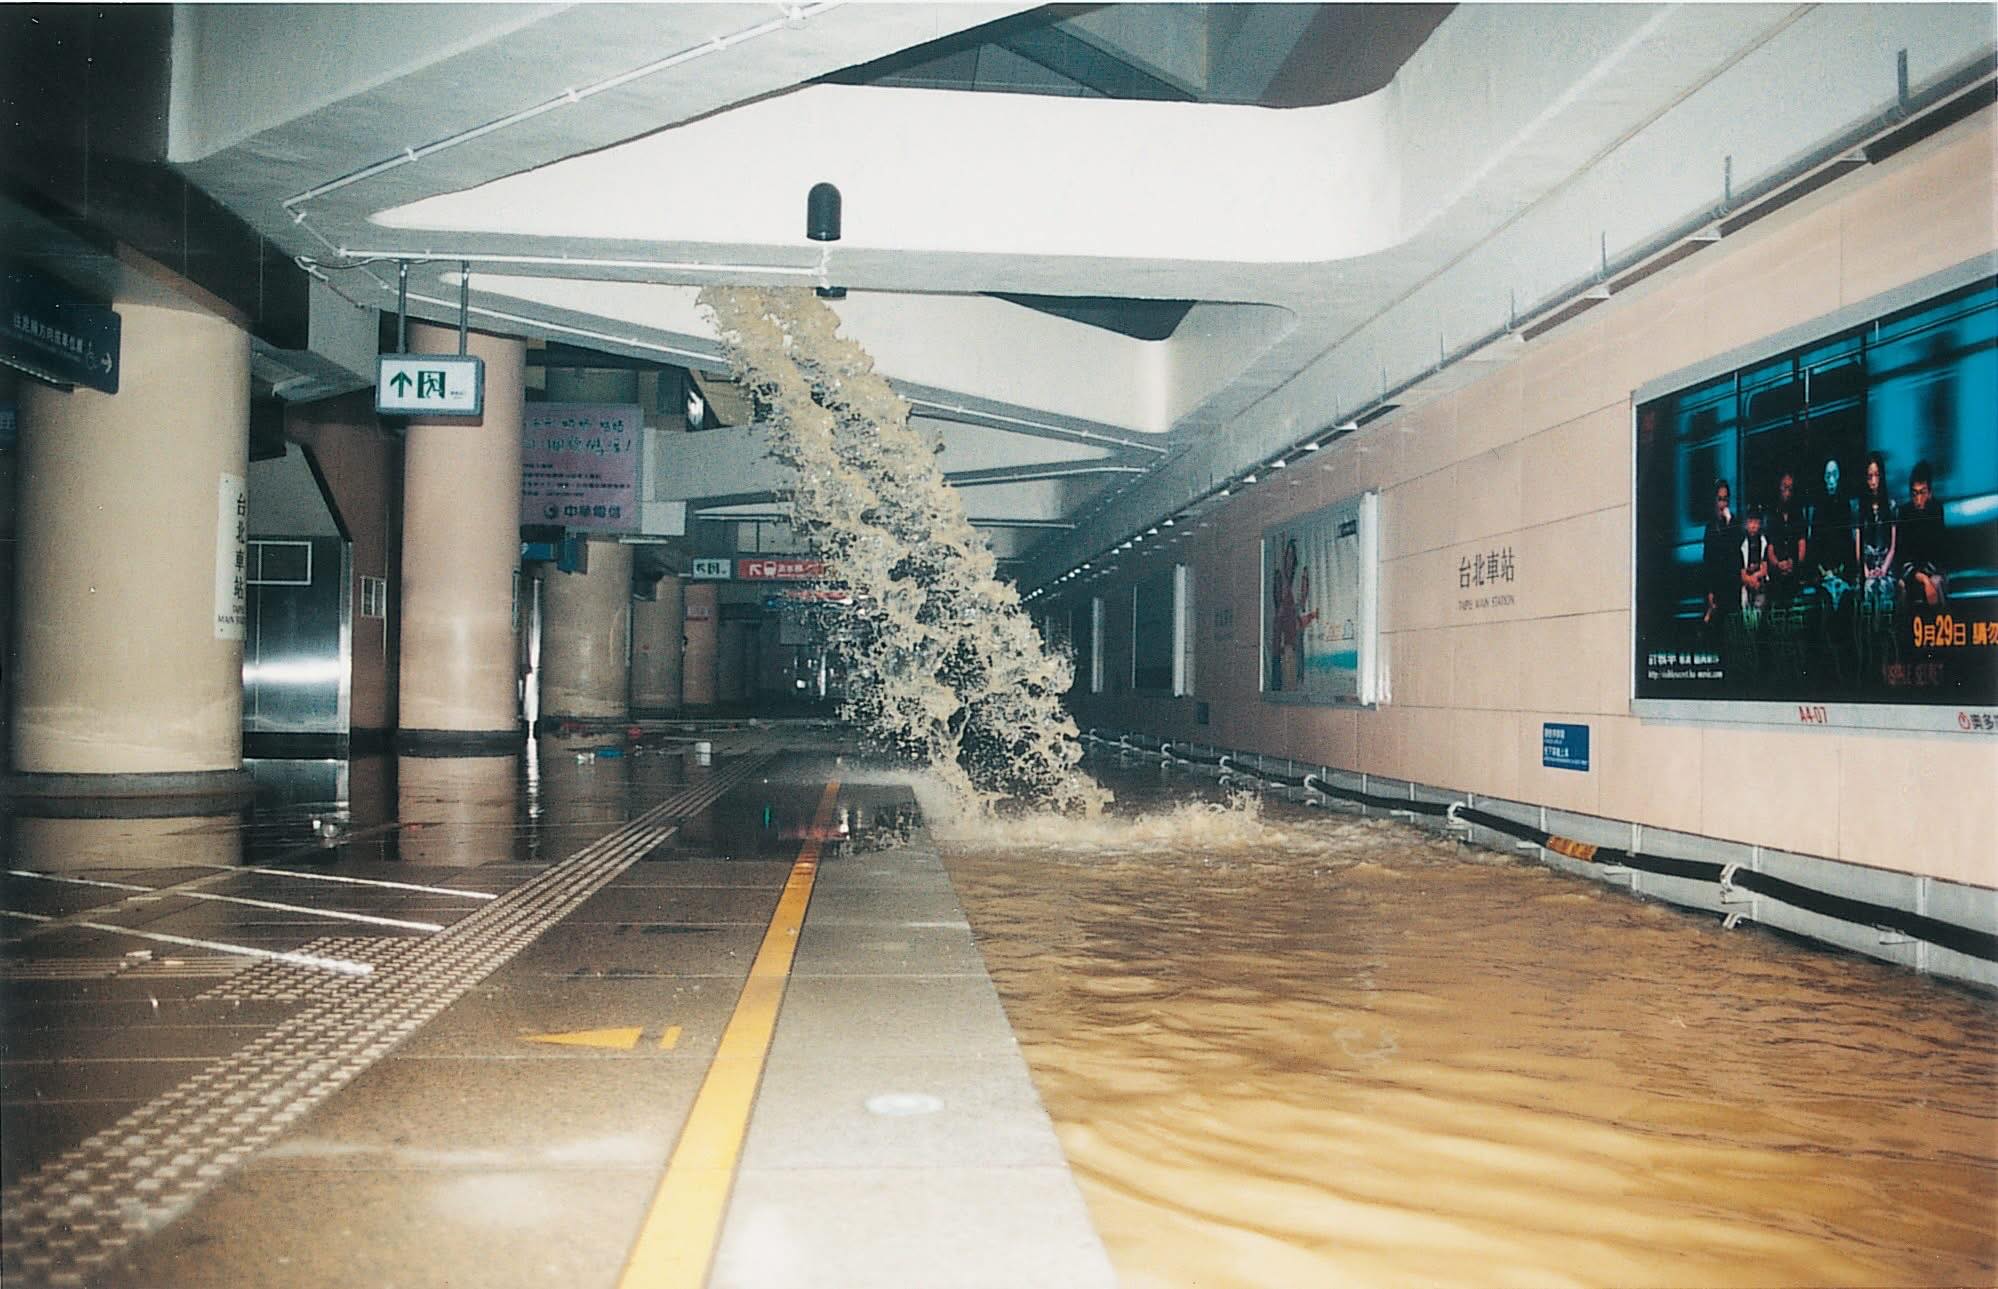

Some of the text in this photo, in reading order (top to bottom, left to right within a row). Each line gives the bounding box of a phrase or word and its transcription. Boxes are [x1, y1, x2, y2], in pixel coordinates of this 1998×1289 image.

[233, 492, 246, 600] 台北車站
[1459, 546, 1516, 588] 台北車站
[1913, 613, 1966, 648] 9月29日
